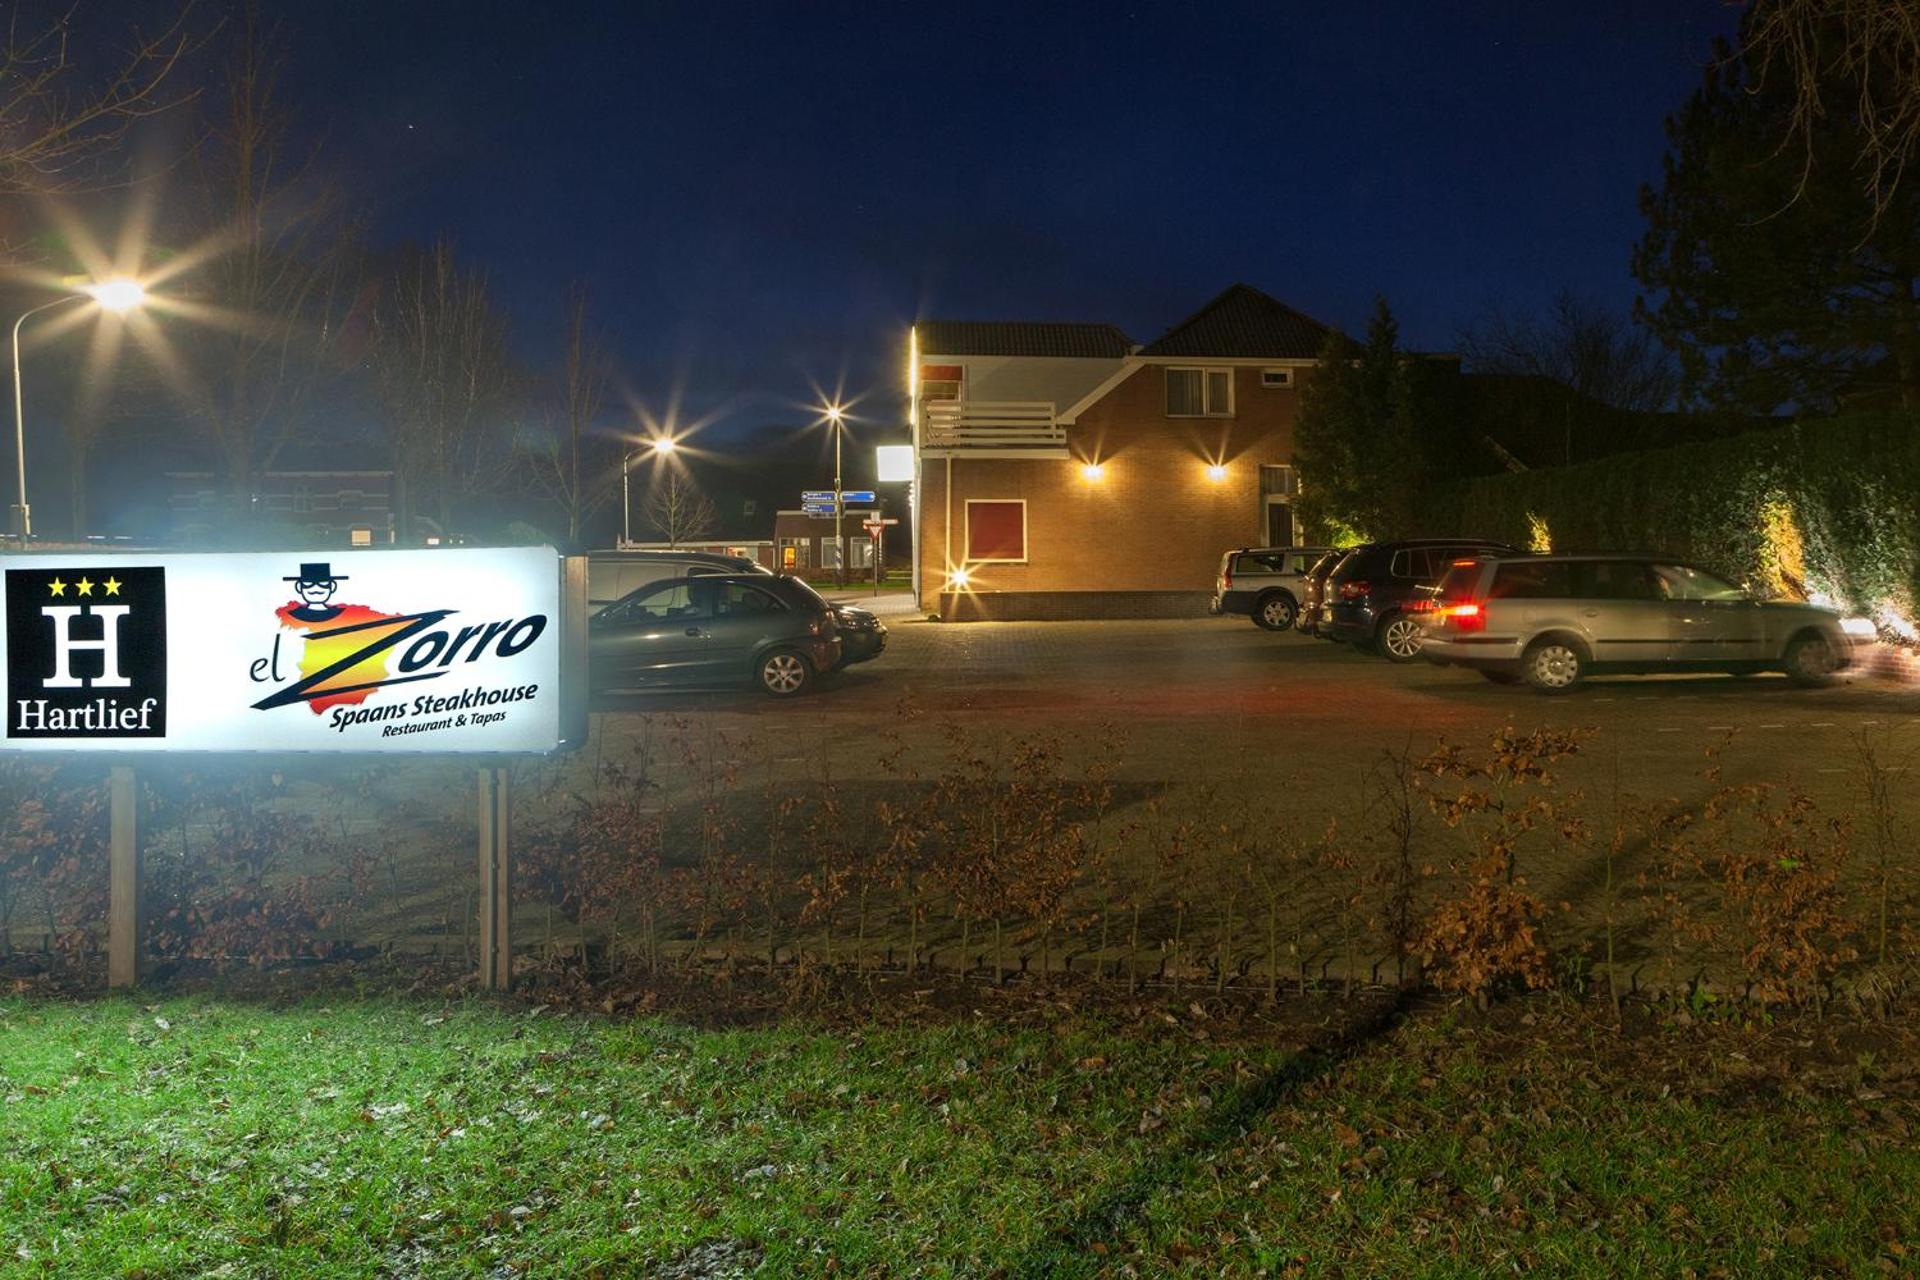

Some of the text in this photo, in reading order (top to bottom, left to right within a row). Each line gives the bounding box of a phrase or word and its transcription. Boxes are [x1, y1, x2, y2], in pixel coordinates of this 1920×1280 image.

[41, 604, 131, 687] H
[249, 609, 548, 711] el Zorro
[16, 698, 157, 730] Hartlief
[329, 684, 539, 732] Spaans Steakhouse
[382, 710, 506, 737] Restaurant & Tapas
